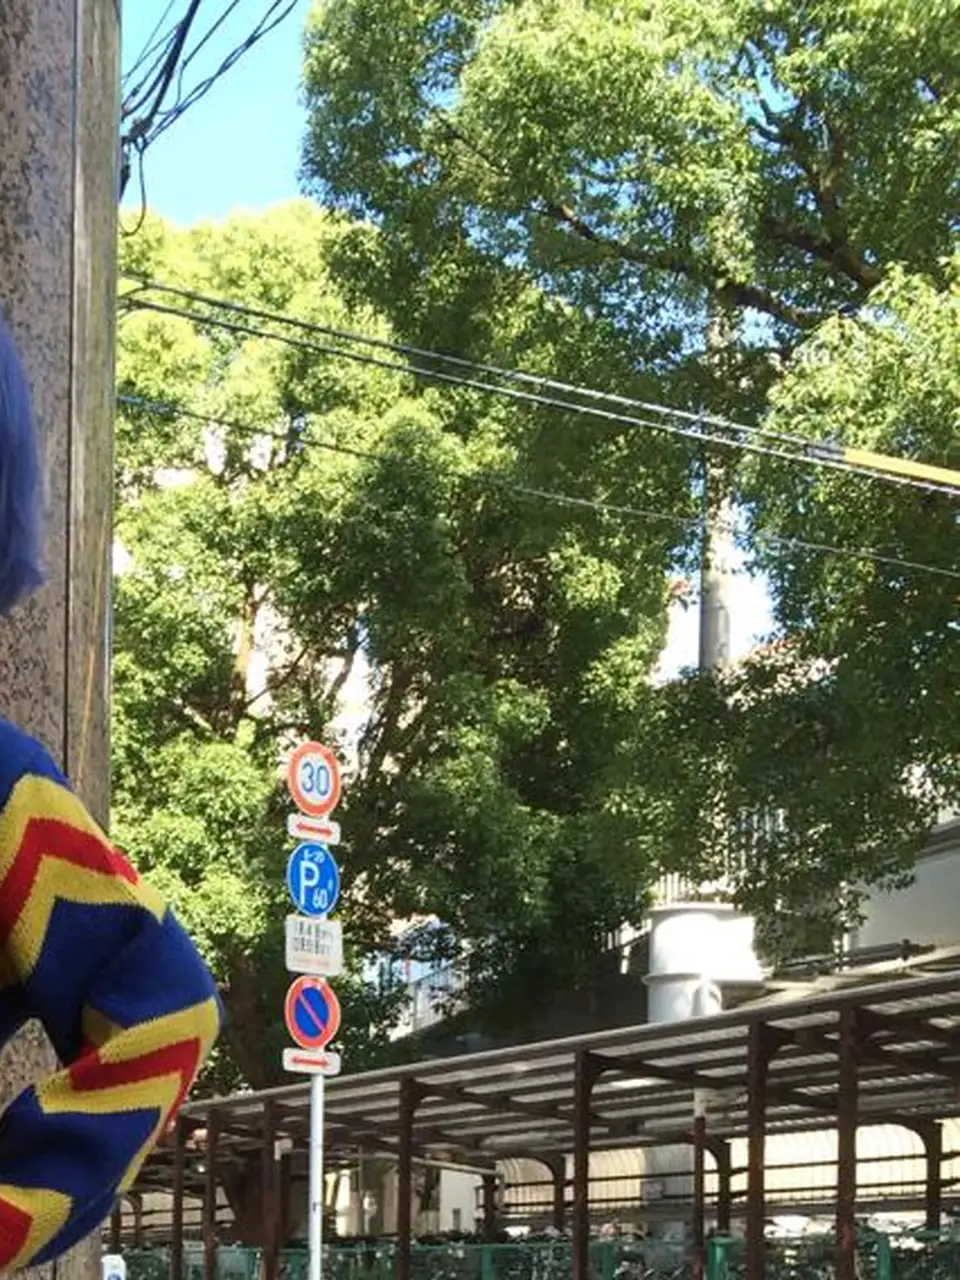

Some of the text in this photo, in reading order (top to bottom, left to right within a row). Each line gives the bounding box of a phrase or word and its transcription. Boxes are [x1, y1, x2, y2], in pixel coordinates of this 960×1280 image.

[302, 762, 330, 796] 30
[300, 859, 320, 905] P
[312, 888, 328, 909] 60
